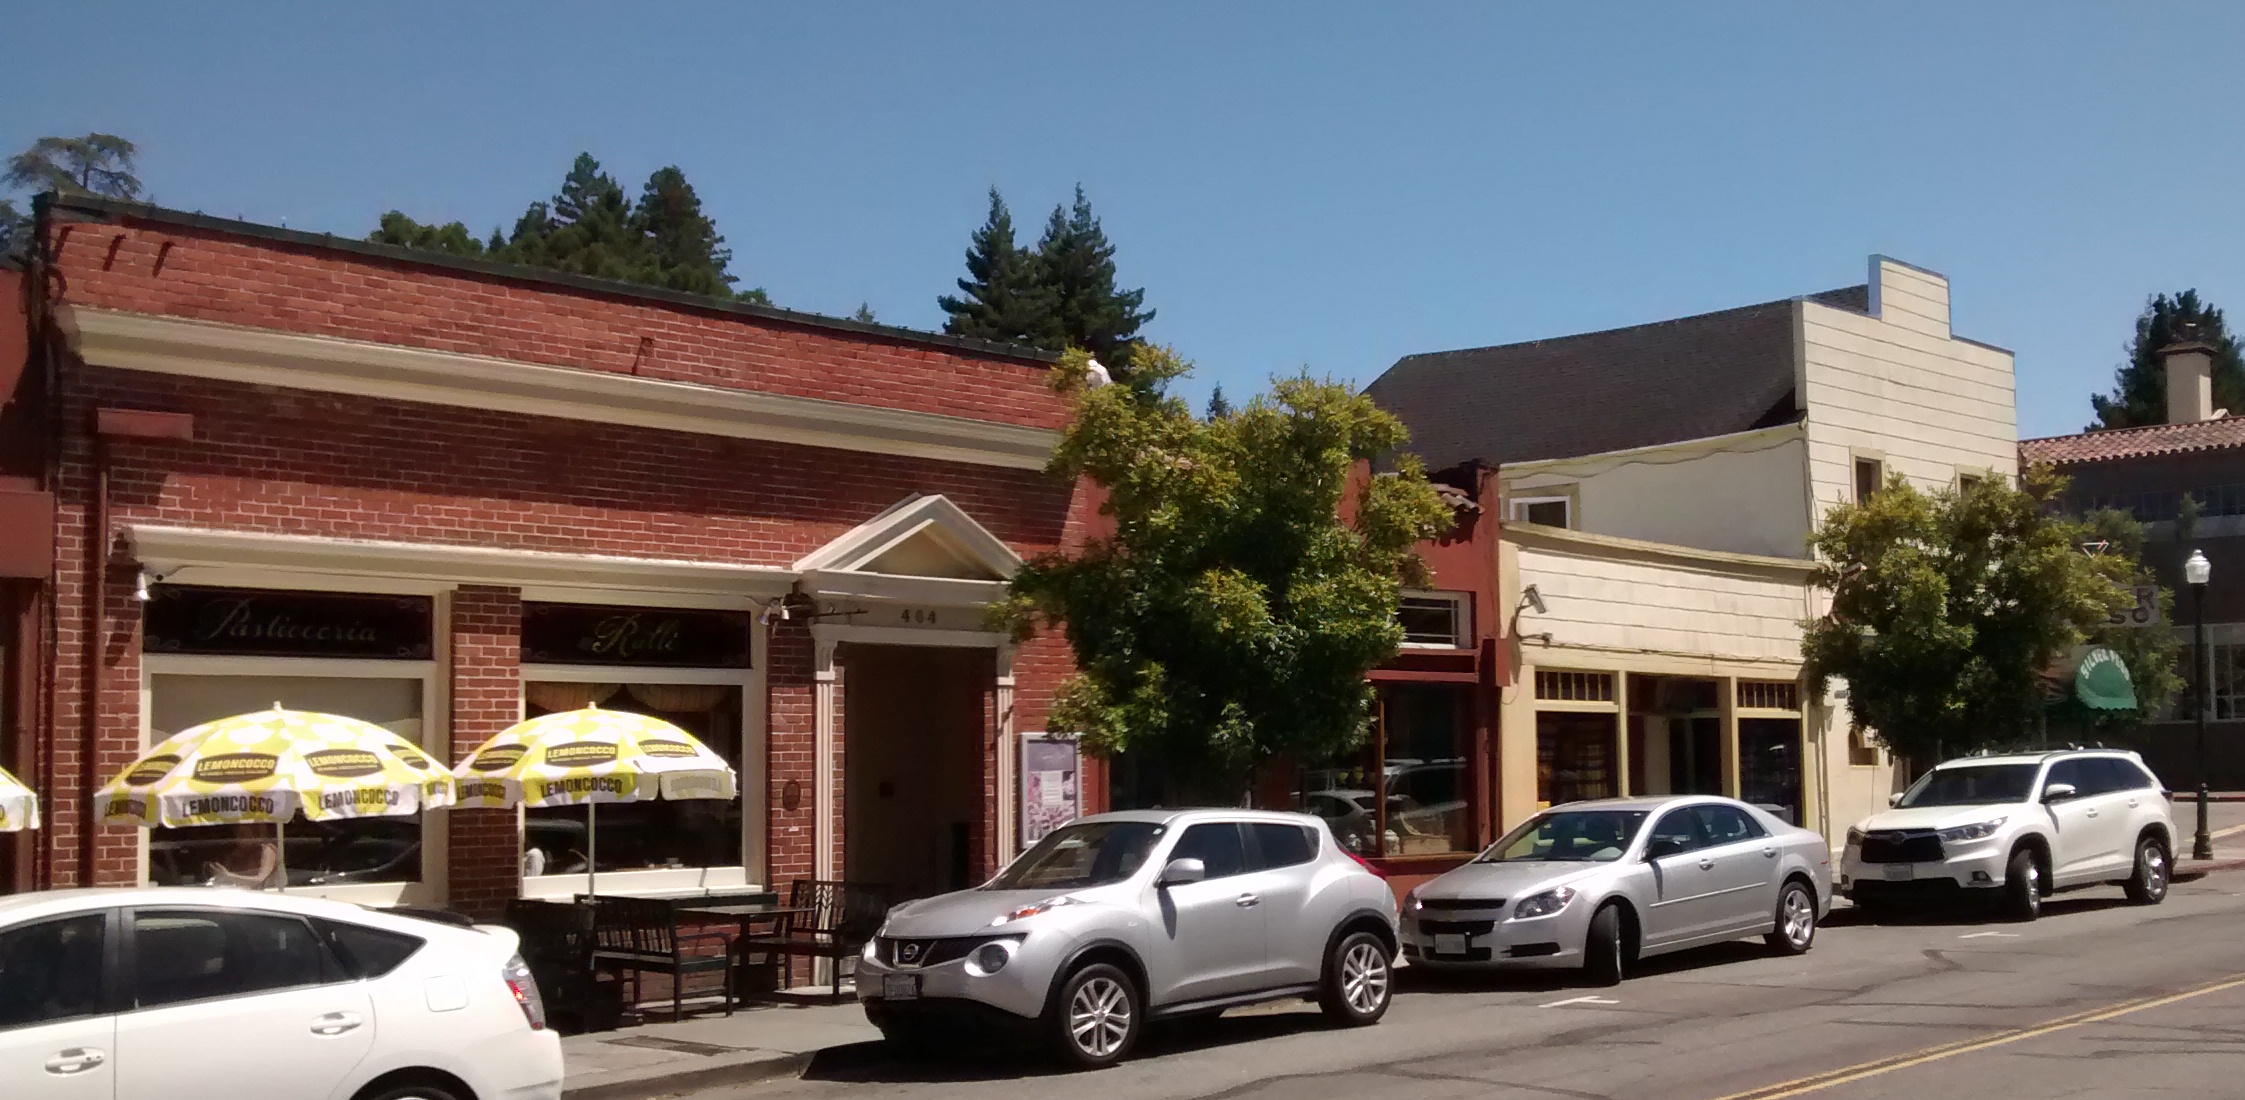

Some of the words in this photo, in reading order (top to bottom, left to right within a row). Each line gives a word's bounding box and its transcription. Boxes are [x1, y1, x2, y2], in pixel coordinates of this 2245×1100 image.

[200, 598, 377, 642] Pasticceria
[900, 609, 937, 624] 404
[197, 758, 276, 772] LEMONCOCCO
[541, 778, 622, 798] LEMONCOCCO
[182, 796, 274, 818] LEMONCOCCO
[319, 789, 399, 810] LEMONCOCCO
